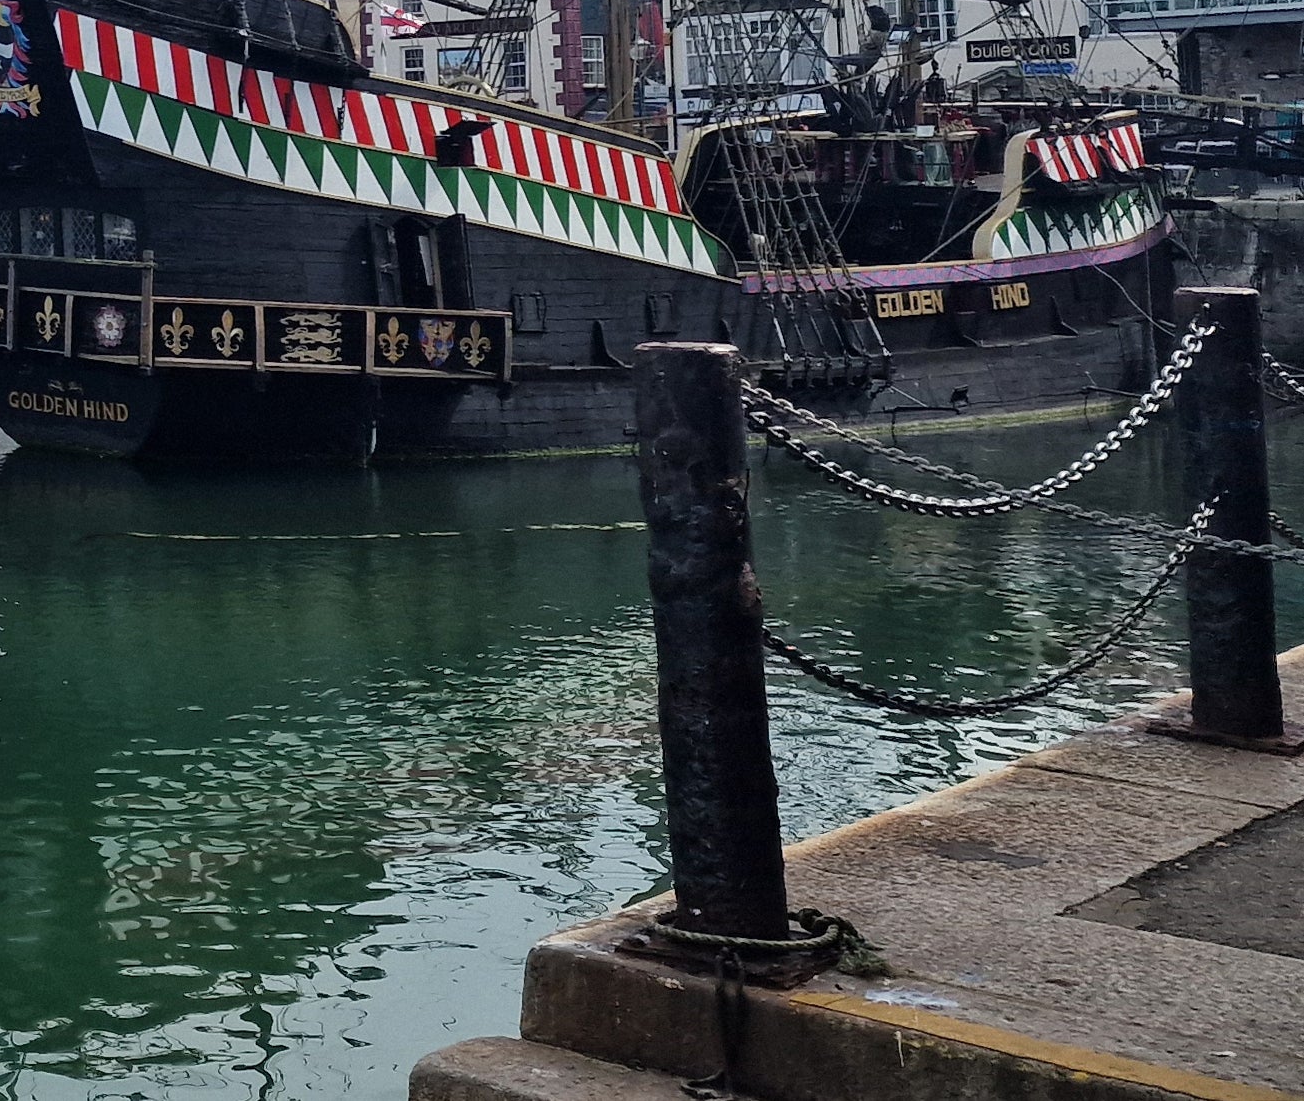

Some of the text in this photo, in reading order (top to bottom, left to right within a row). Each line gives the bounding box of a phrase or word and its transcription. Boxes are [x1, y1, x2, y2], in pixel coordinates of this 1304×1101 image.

[875, 282, 1030, 318] GOLDEN HIND
[9, 391, 129, 422] GOLDEN HIND
